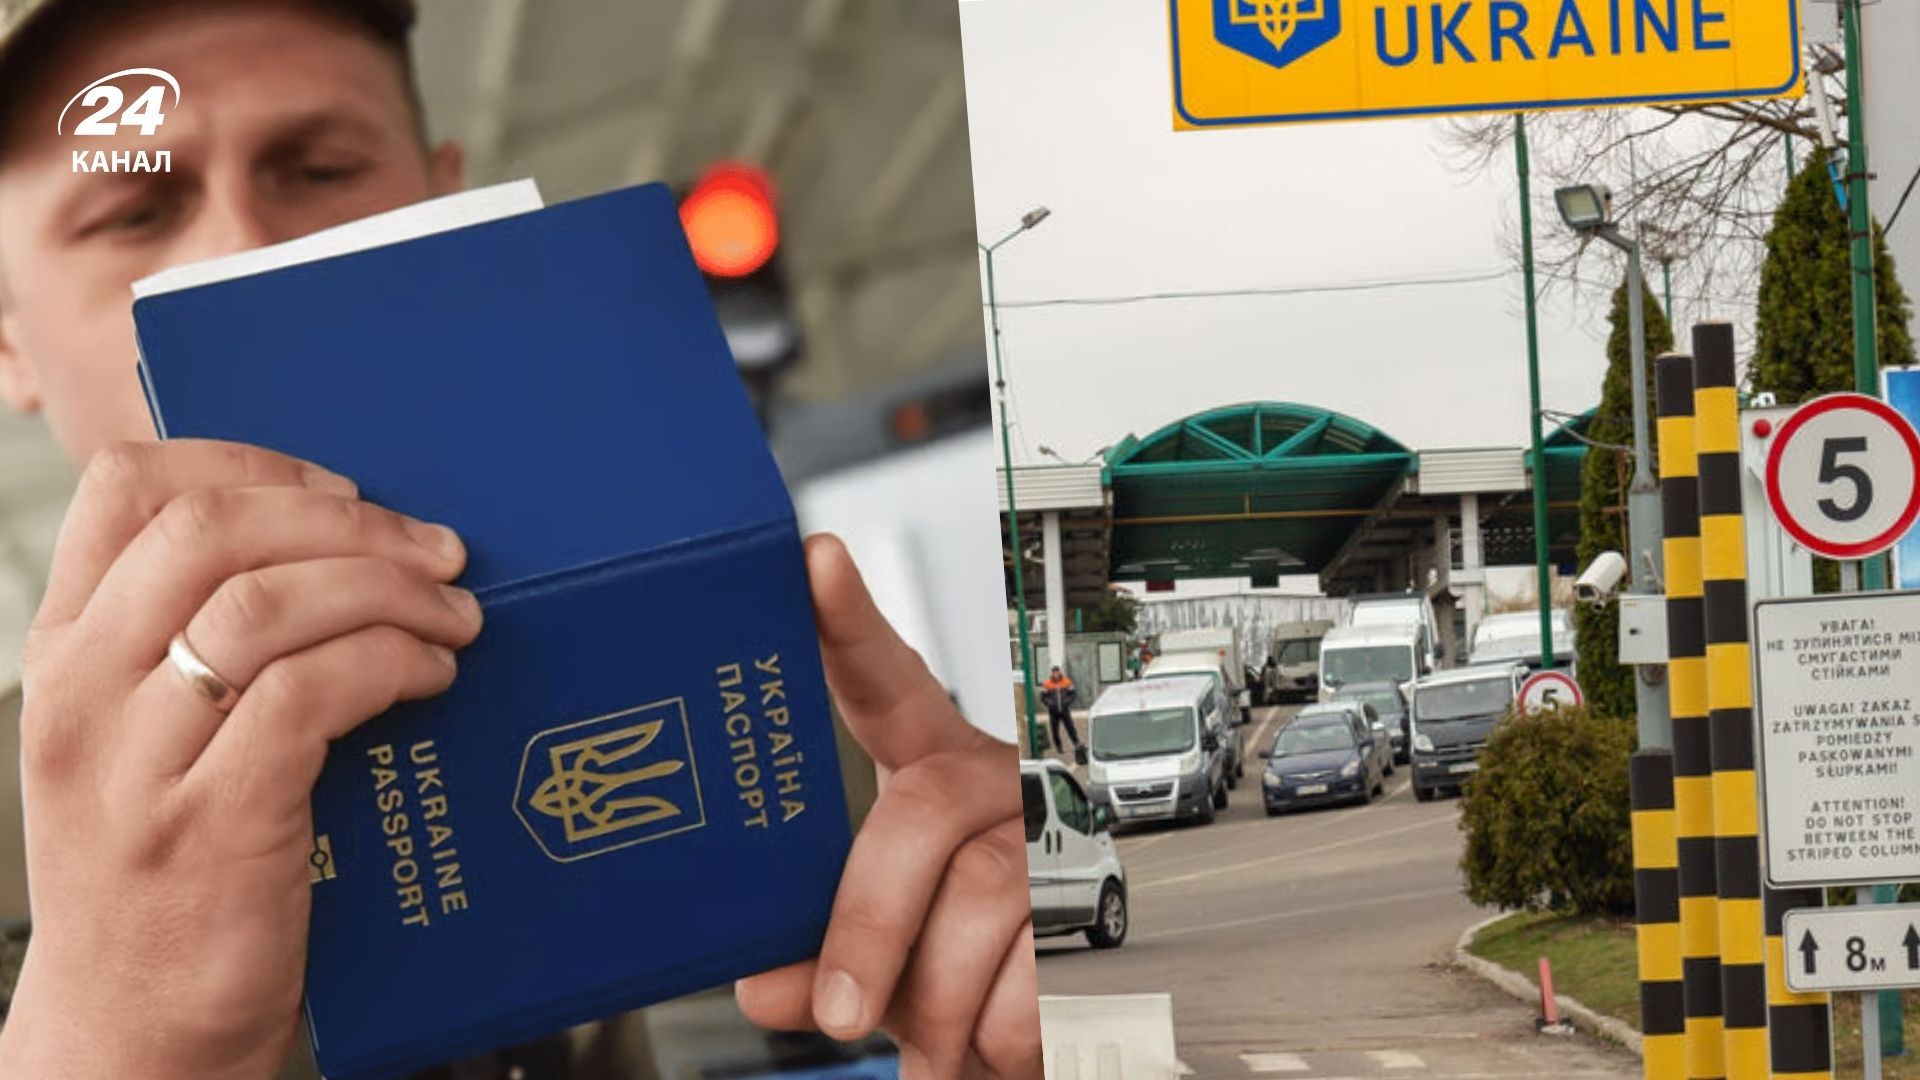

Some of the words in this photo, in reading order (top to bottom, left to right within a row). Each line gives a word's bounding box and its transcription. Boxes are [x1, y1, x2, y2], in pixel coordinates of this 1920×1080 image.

[1374, 0, 1731, 67] UKRAINE
[1817, 436, 1873, 522] 5
[1819, 618, 1875, 633] УВАГА!
[1766, 639, 1785, 651] НЕ
[1793, 632, 1892, 650] ЗУПИНЯТИСЯ
[1797, 648, 1902, 666] СМУГАСТИМИ
[1811, 664, 1890, 681] СТІЙКАМИ
[1793, 701, 1854, 717] UWAGA!
[1861, 699, 1911, 713] ZAKAZ
[1772, 714, 1906, 734] ZATRZYMYWANIA
[715, 662, 769, 829] ПАСПОРТ
[755, 653, 805, 822] УКРАЇНА
[1798, 746, 1912, 762] PASKOWANYMI
[1811, 797, 1905, 813] ATTENTION!
[410, 740, 468, 914] UKRAINE
[1805, 816, 1827, 830] DO
[1833, 814, 1864, 828] NOT
[1872, 812, 1912, 826] STOP
[367, 744, 430, 926] PASSPORT
[1804, 830, 1879, 845] BETWEEN
[1886, 827, 1915, 841] THE
[1788, 846, 1853, 862] STRIPED
